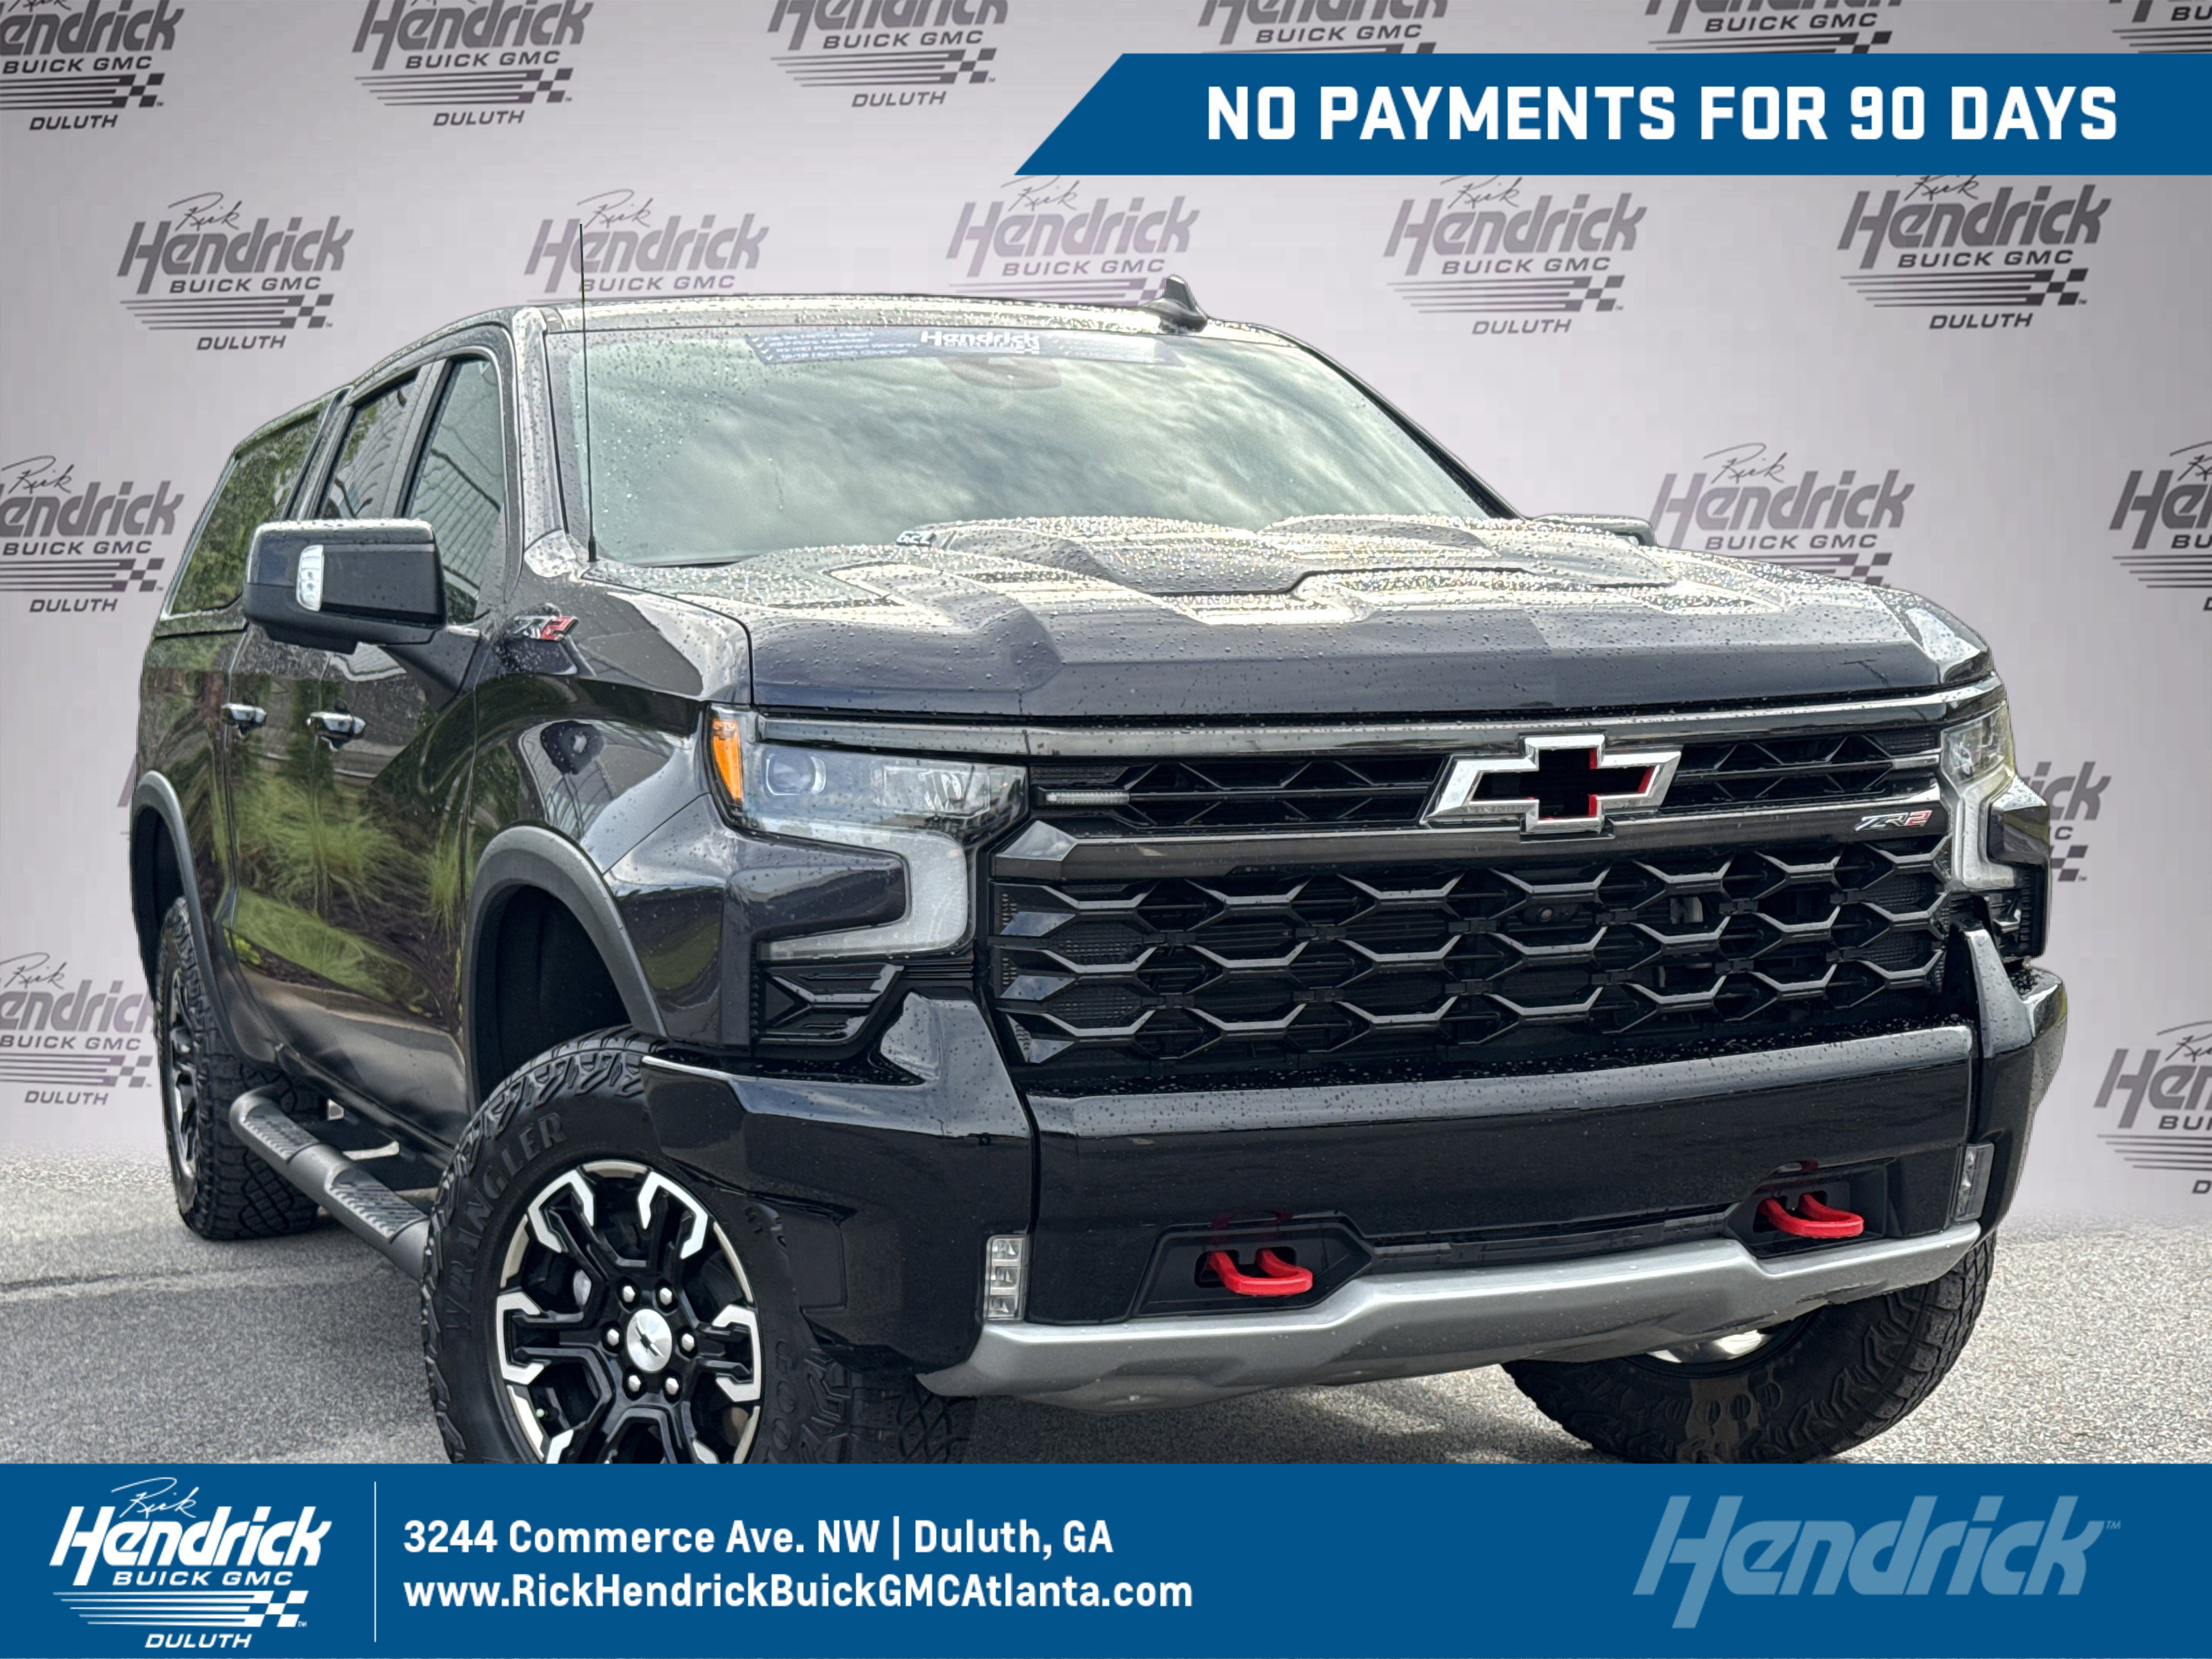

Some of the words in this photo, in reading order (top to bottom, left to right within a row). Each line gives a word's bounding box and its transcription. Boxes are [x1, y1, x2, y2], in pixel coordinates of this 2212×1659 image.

[0, 0, 184, 56] endrick
[1705, 15, 1799, 32] BUICK
[1810, 13, 1877, 29] GMC
[352, 0, 592, 70] Hendrick
[823, 33, 911, 49] BUICK
[920, 31, 983, 46] GMC
[1256, 27, 1347, 43] BUICK
[1357, 24, 1422, 39] GMC
[3, 58, 84, 74] BUICK
[93, 56, 152, 71] GMC
[405, 53, 490, 69] BUICK
[499, 51, 560, 66] GMC
[851, 91, 946, 108] DULUTH
[30, 115, 118, 130] DULUTH
[433, 110, 524, 126] DULUTH
[1383, 193, 1647, 275] Hendrick
[1837, 184, 2112, 269] Hendrick
[945, 196, 1200, 278] Hendrick
[117, 216, 354, 294] Hendrick
[524, 213, 769, 293] Hendrick
[1898, 251, 1994, 268] BUICK
[2004, 250, 2073, 266] GMC
[1002, 261, 1091, 276] BUICK
[1101, 258, 1165, 273] GMC
[1441, 259, 1534, 274] BUICK
[1544, 257, 1611, 272] GMC
[169, 279, 251, 294] BUICK
[261, 276, 321, 291] GMC
[578, 276, 664, 292] BUICK
[673, 275, 736, 290] GMC
[1472, 319, 1572, 335] DULUTH
[1929, 313, 2033, 329] DULUTH
[196, 335, 286, 350] DULUTH
[0, 481, 185, 537] endrick
[1649, 470, 1915, 549] Hendrick
[2, 541, 84, 555] BUICK
[93, 540, 152, 554] GMC
[1705, 535, 1799, 550] BUICK
[1809, 534, 1878, 549] GMC
[29, 599, 118, 613] DULUTH
[1854, 809, 1933, 832] ZR2
[0, 979, 155, 1034] endric
[0, 1035, 76, 1049] BUICK
[85, 1037, 142, 1051] GMC
[24, 1090, 109, 1105] DULUTH
